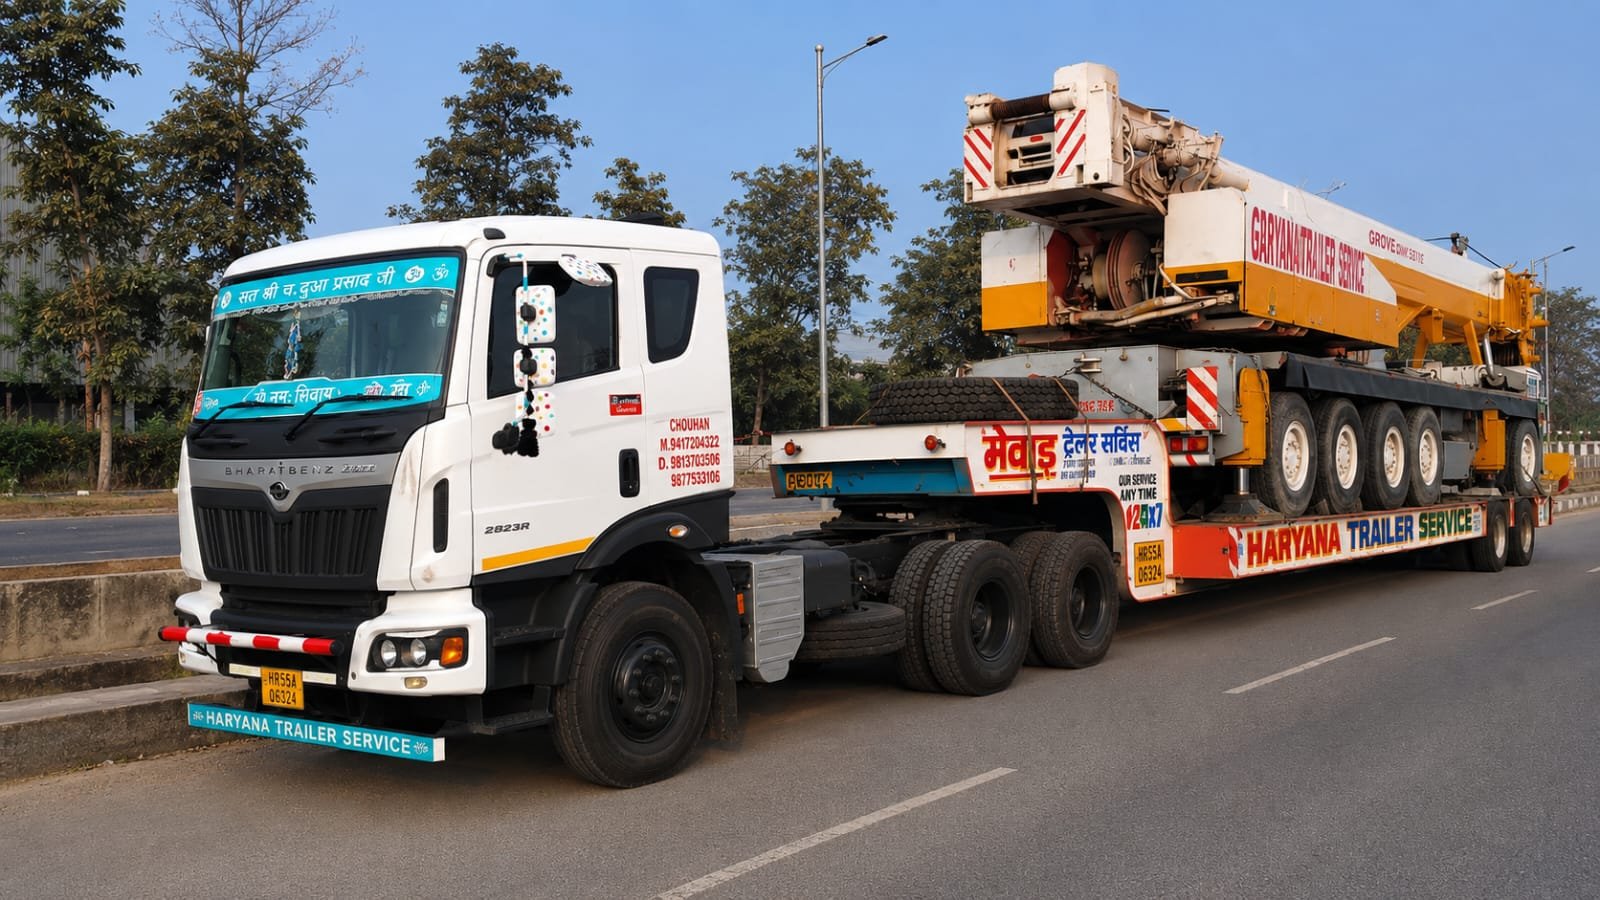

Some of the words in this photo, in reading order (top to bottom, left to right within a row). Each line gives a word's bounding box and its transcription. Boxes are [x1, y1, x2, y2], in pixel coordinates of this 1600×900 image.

[1369, 230, 1396, 254] GROVE
[332, 273, 372, 291] प्रसाद
[377, 265, 396, 286] जी
[670, 417, 710, 432] CHOUHAN
[1062, 426, 1098, 459] ट्रेलर
[1100, 425, 1142, 454] सर्विस
[225, 465, 334, 476] BHARATBENZ
[658, 456, 669, 470] D.
[1119, 474, 1131, 486] OUR
[1132, 473, 1157, 486] SERVICE
[1120, 488, 1136, 501] ANY
[1138, 487, 1157, 500] TIME
[484, 522, 530, 535] 2823R
[1247, 522, 1341, 568] HARYANA
[1347, 514, 1415, 550] TRAILER
[1418, 508, 1473, 541] SERVICE
[268, 671, 298, 689] HR55A
[206, 711, 270, 733] HARYANA
[275, 719, 337, 743] TRAILER
[343, 733, 411, 754] SERVICE
